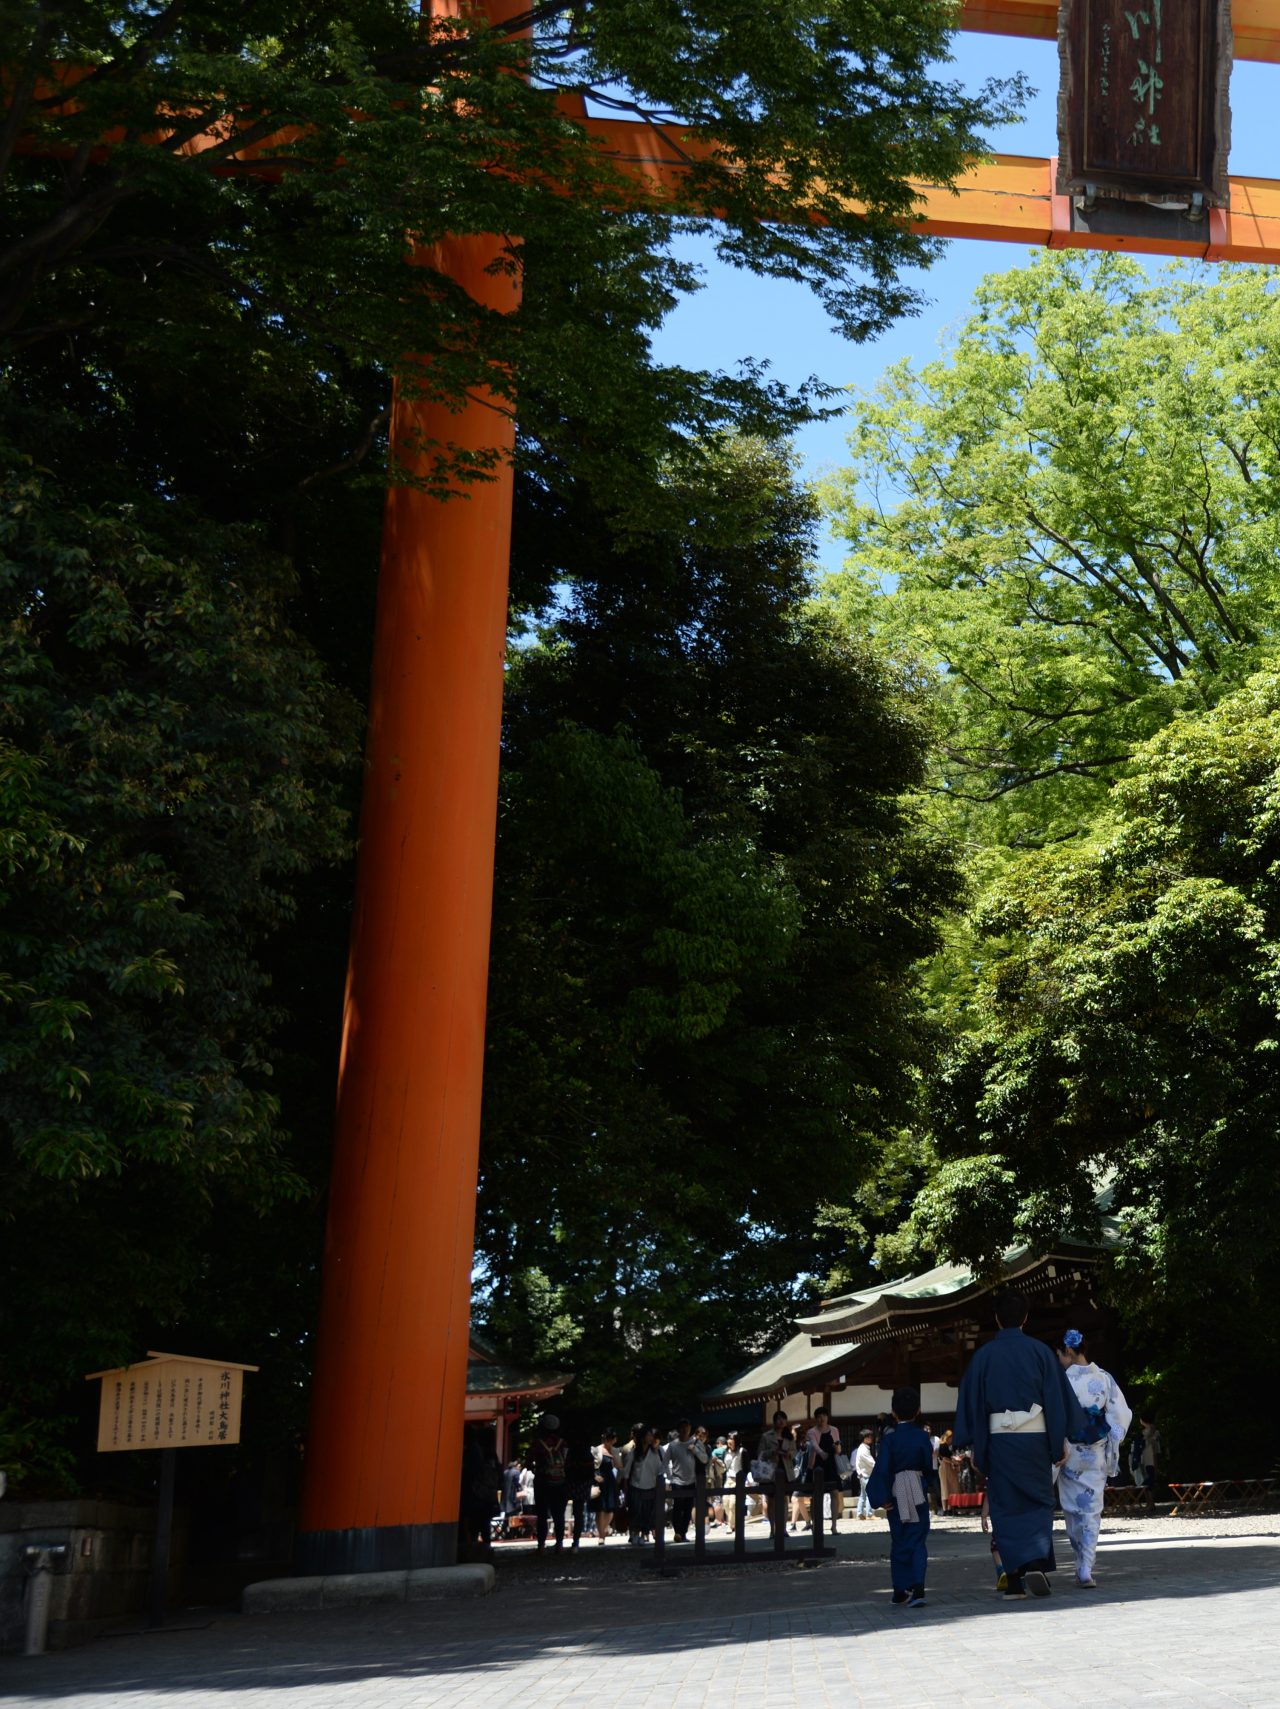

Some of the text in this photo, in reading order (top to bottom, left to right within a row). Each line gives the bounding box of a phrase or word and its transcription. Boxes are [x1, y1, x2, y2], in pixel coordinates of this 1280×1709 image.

[218, 1370, 231, 1441] 氷川神社大鳥居
